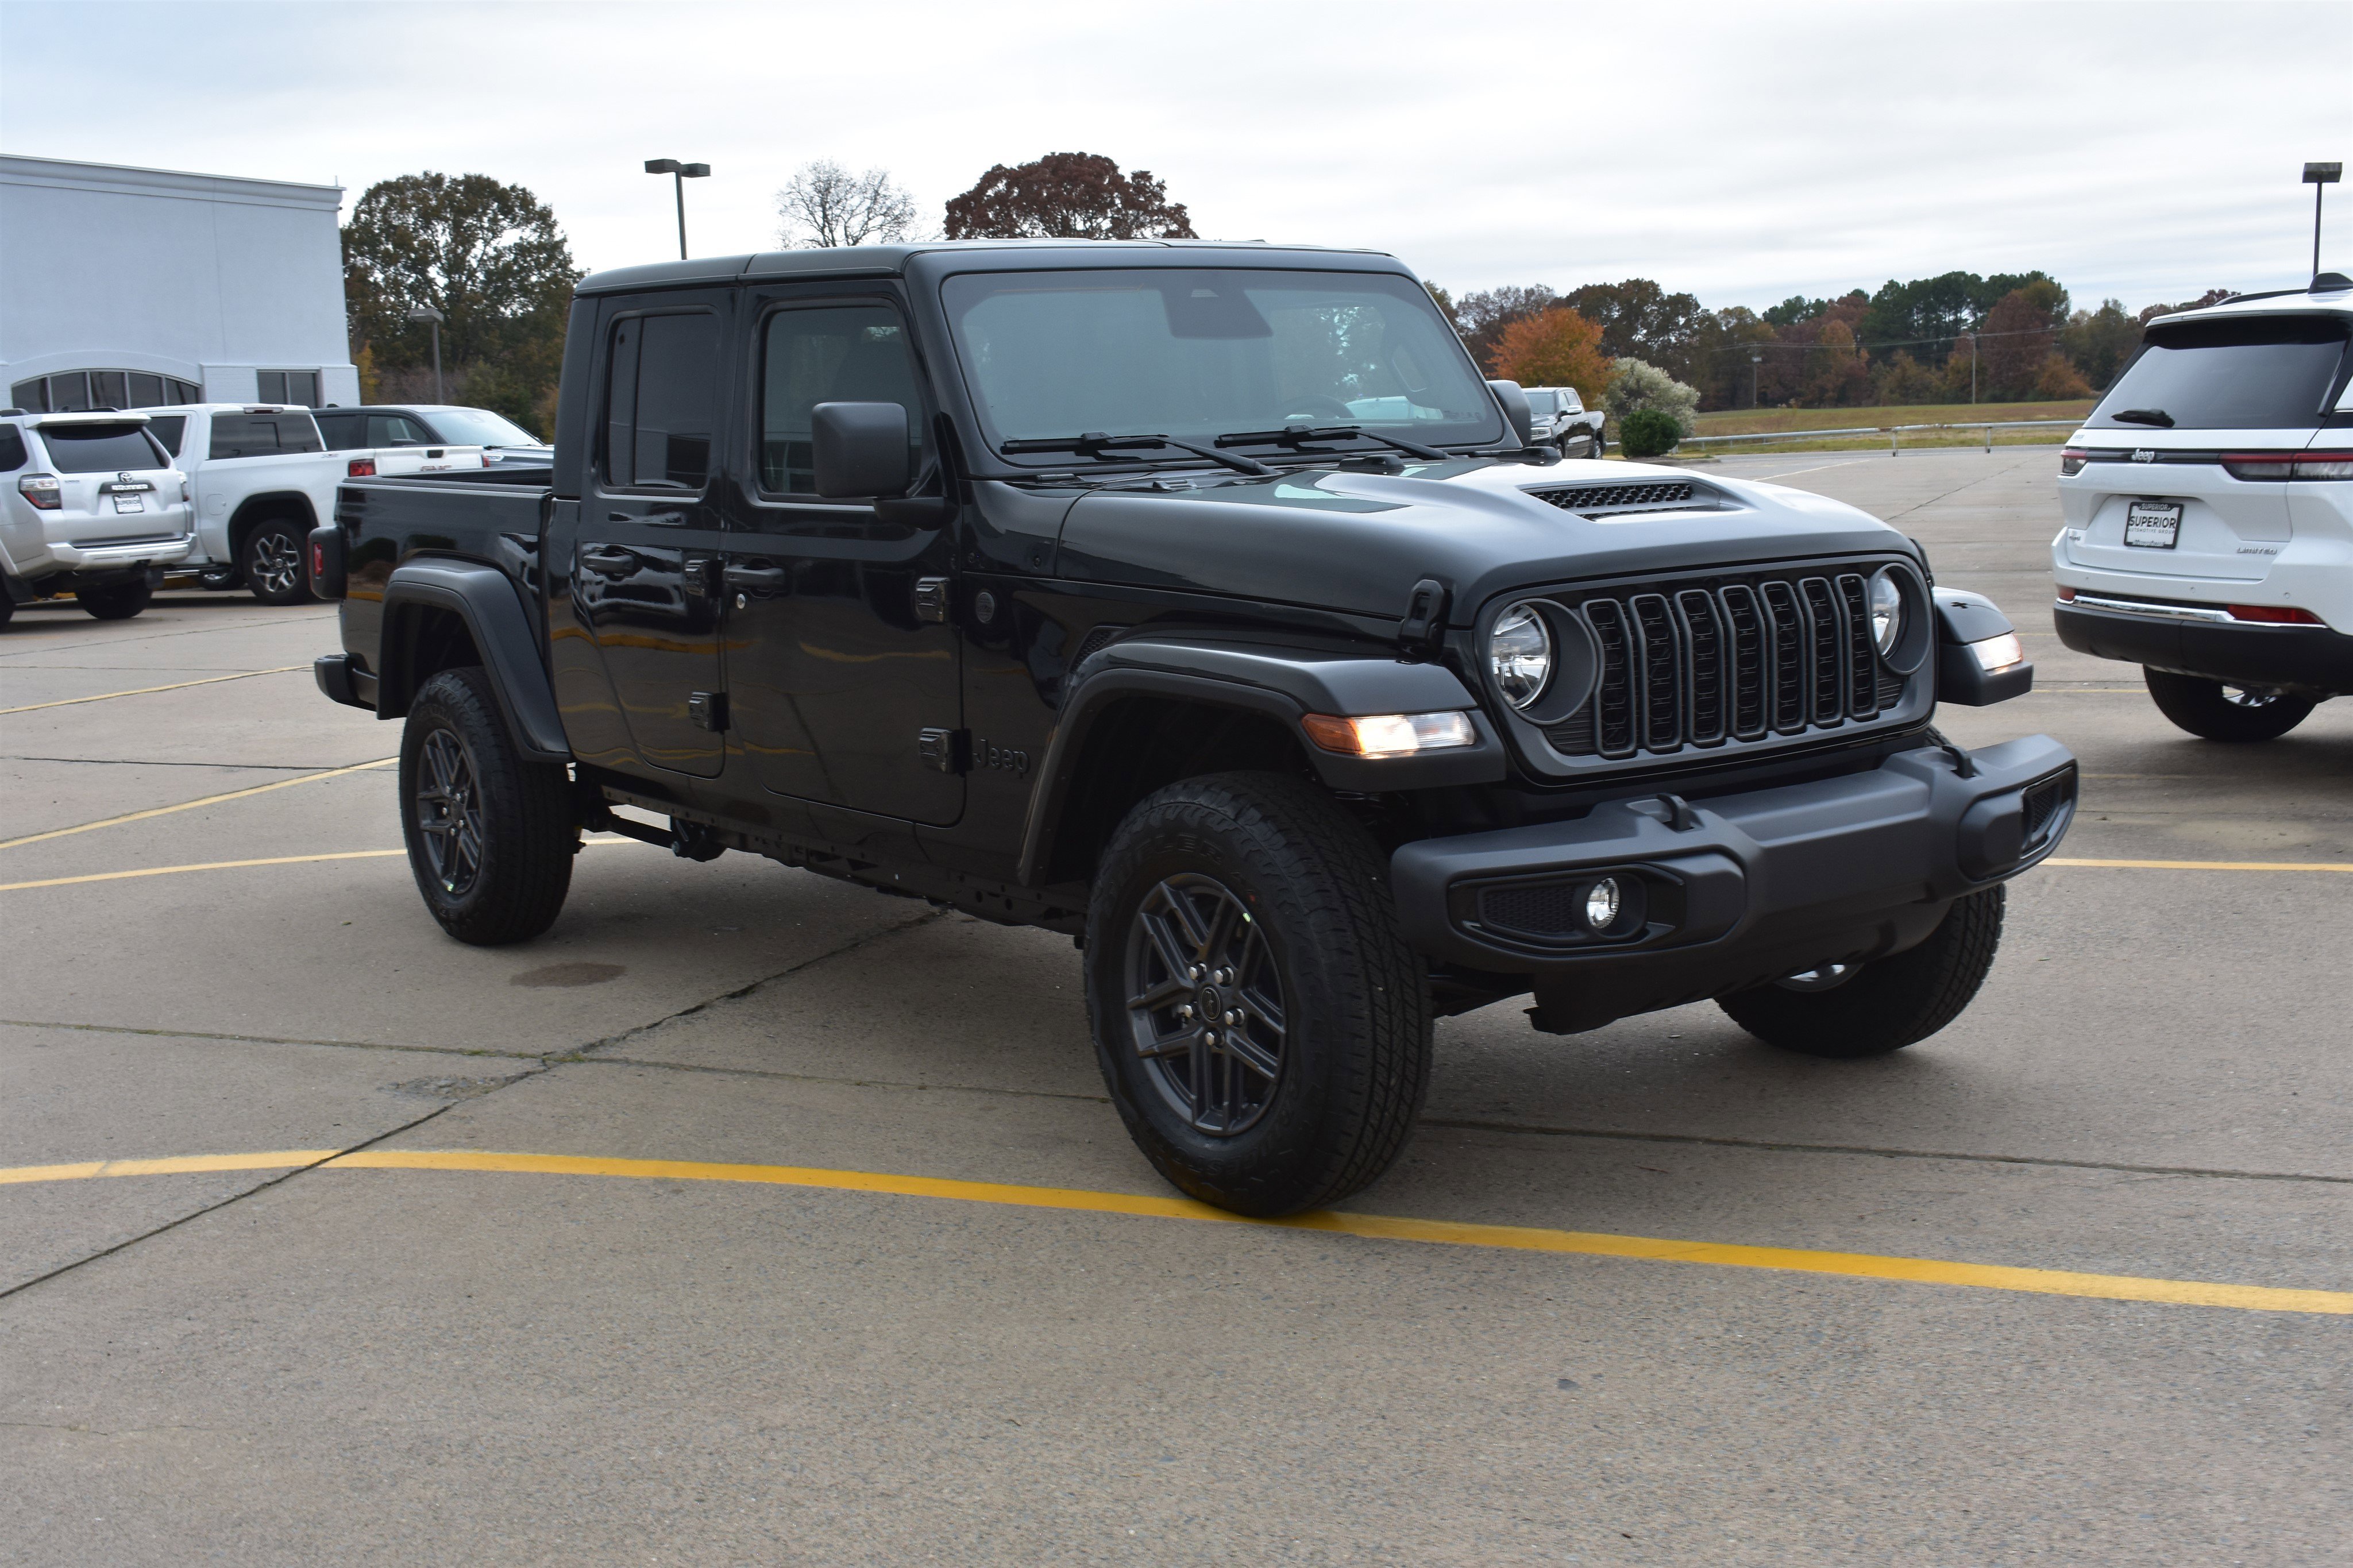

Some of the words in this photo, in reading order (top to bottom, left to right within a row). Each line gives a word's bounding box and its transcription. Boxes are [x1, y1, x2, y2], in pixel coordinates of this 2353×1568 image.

[2131, 449, 2155, 463] Jeep
[2128, 516, 2177, 528] SUPERIOR
[972, 739, 1030, 779] Jeep
